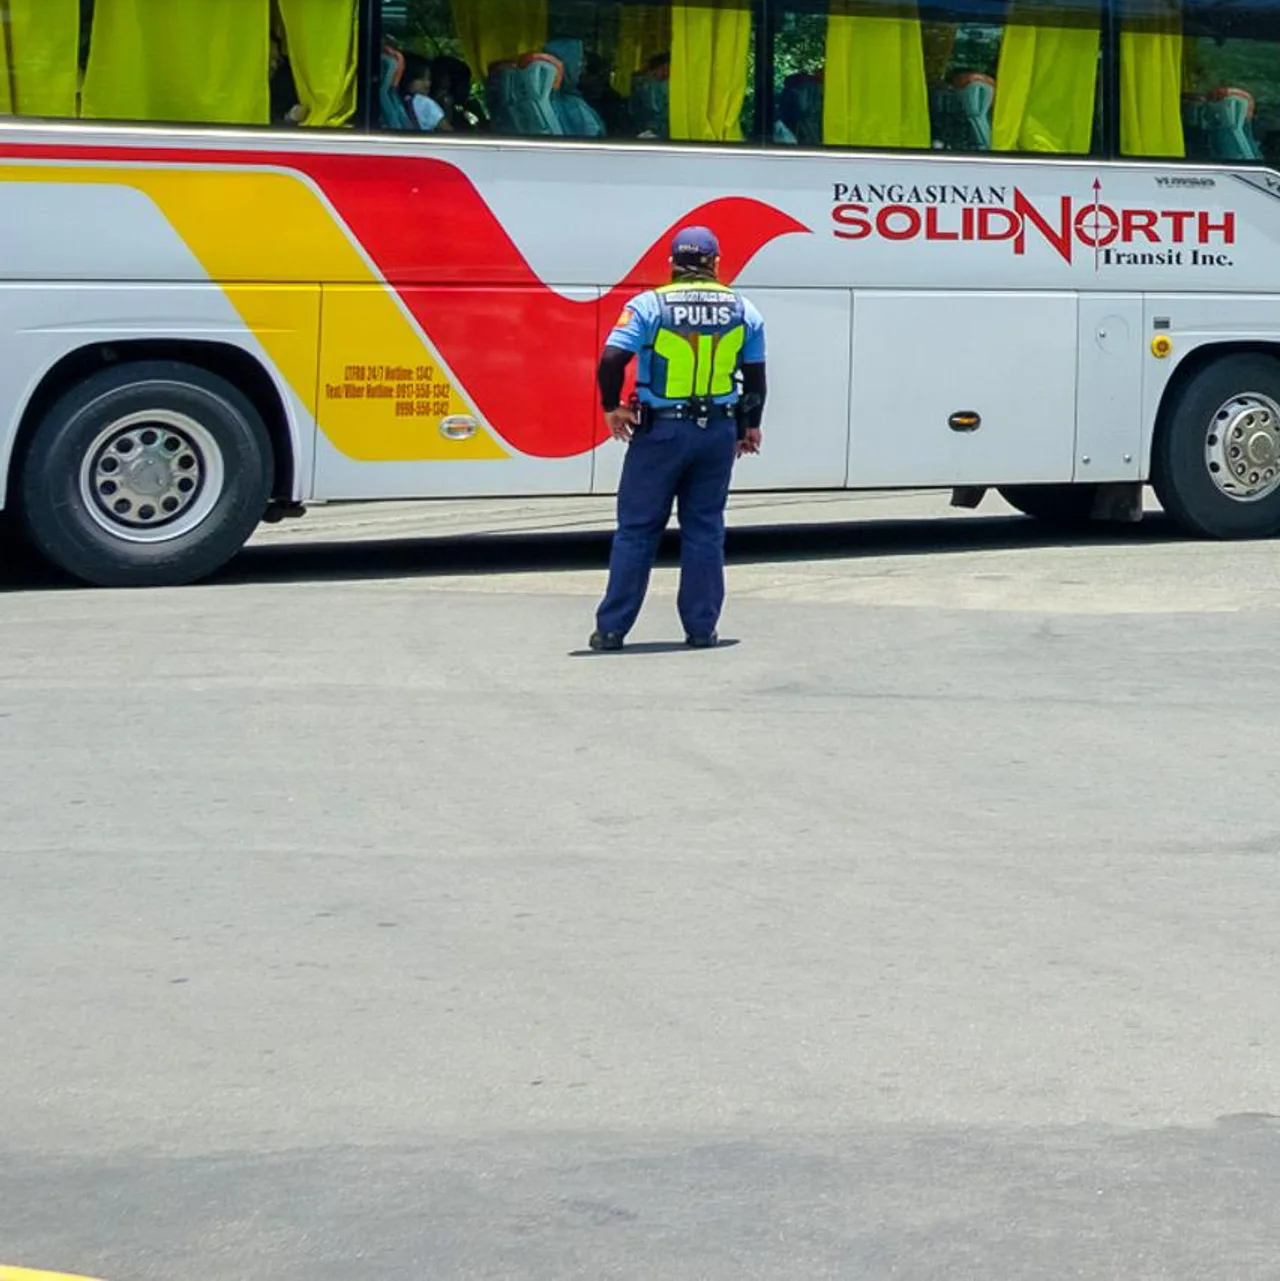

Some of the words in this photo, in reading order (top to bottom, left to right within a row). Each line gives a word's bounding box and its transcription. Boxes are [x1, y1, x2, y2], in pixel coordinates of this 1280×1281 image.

[833, 183, 1006, 204] PANGASINAN
[1101, 248, 1186, 266] Transit
[1192, 249, 1234, 267] Inc.
[673, 306, 731, 325] PULIS
